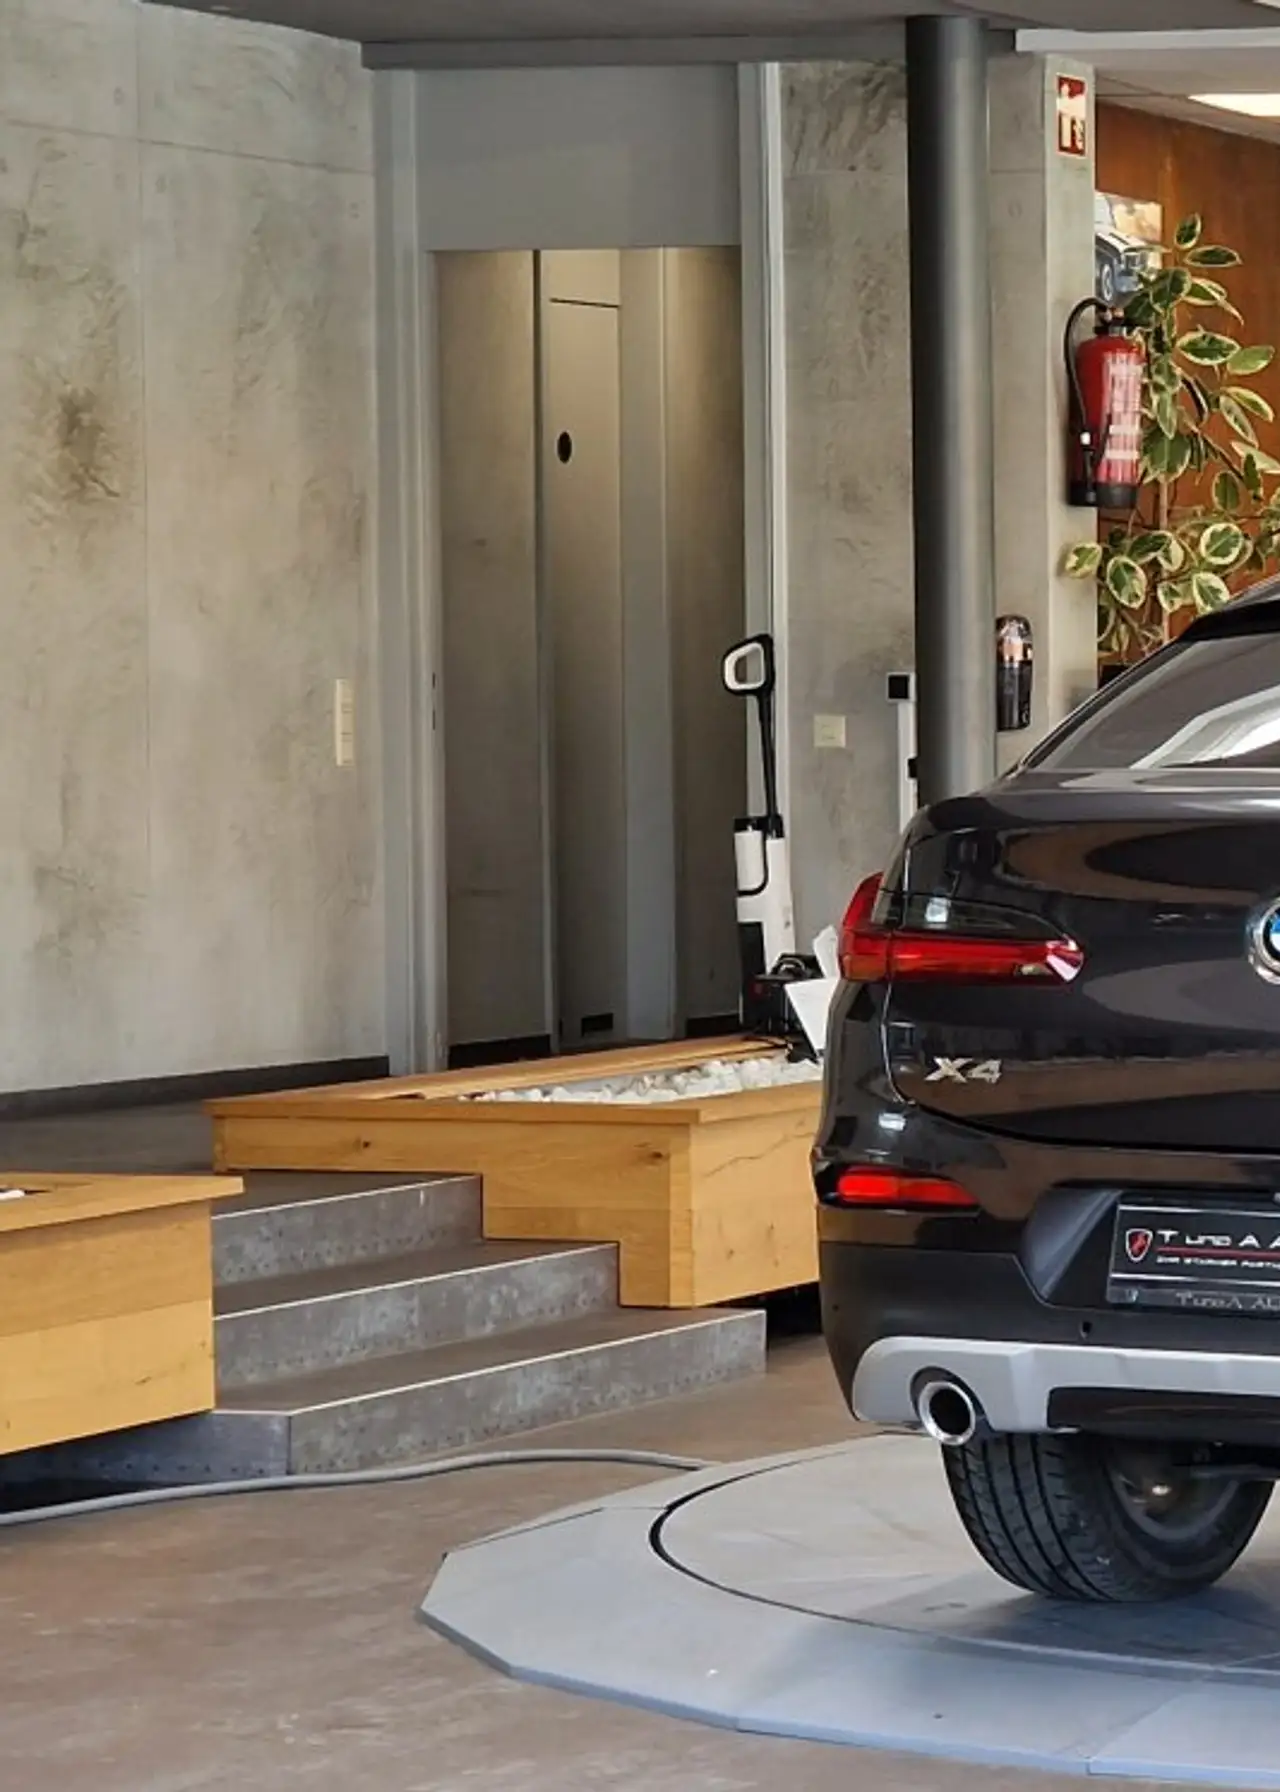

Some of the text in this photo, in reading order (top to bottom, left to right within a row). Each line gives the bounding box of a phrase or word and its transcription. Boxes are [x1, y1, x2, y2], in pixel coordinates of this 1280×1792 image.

[925, 1056, 1002, 1084] X4
[1157, 1230, 1180, 1244] T
[1238, 1234, 1261, 1249] A
